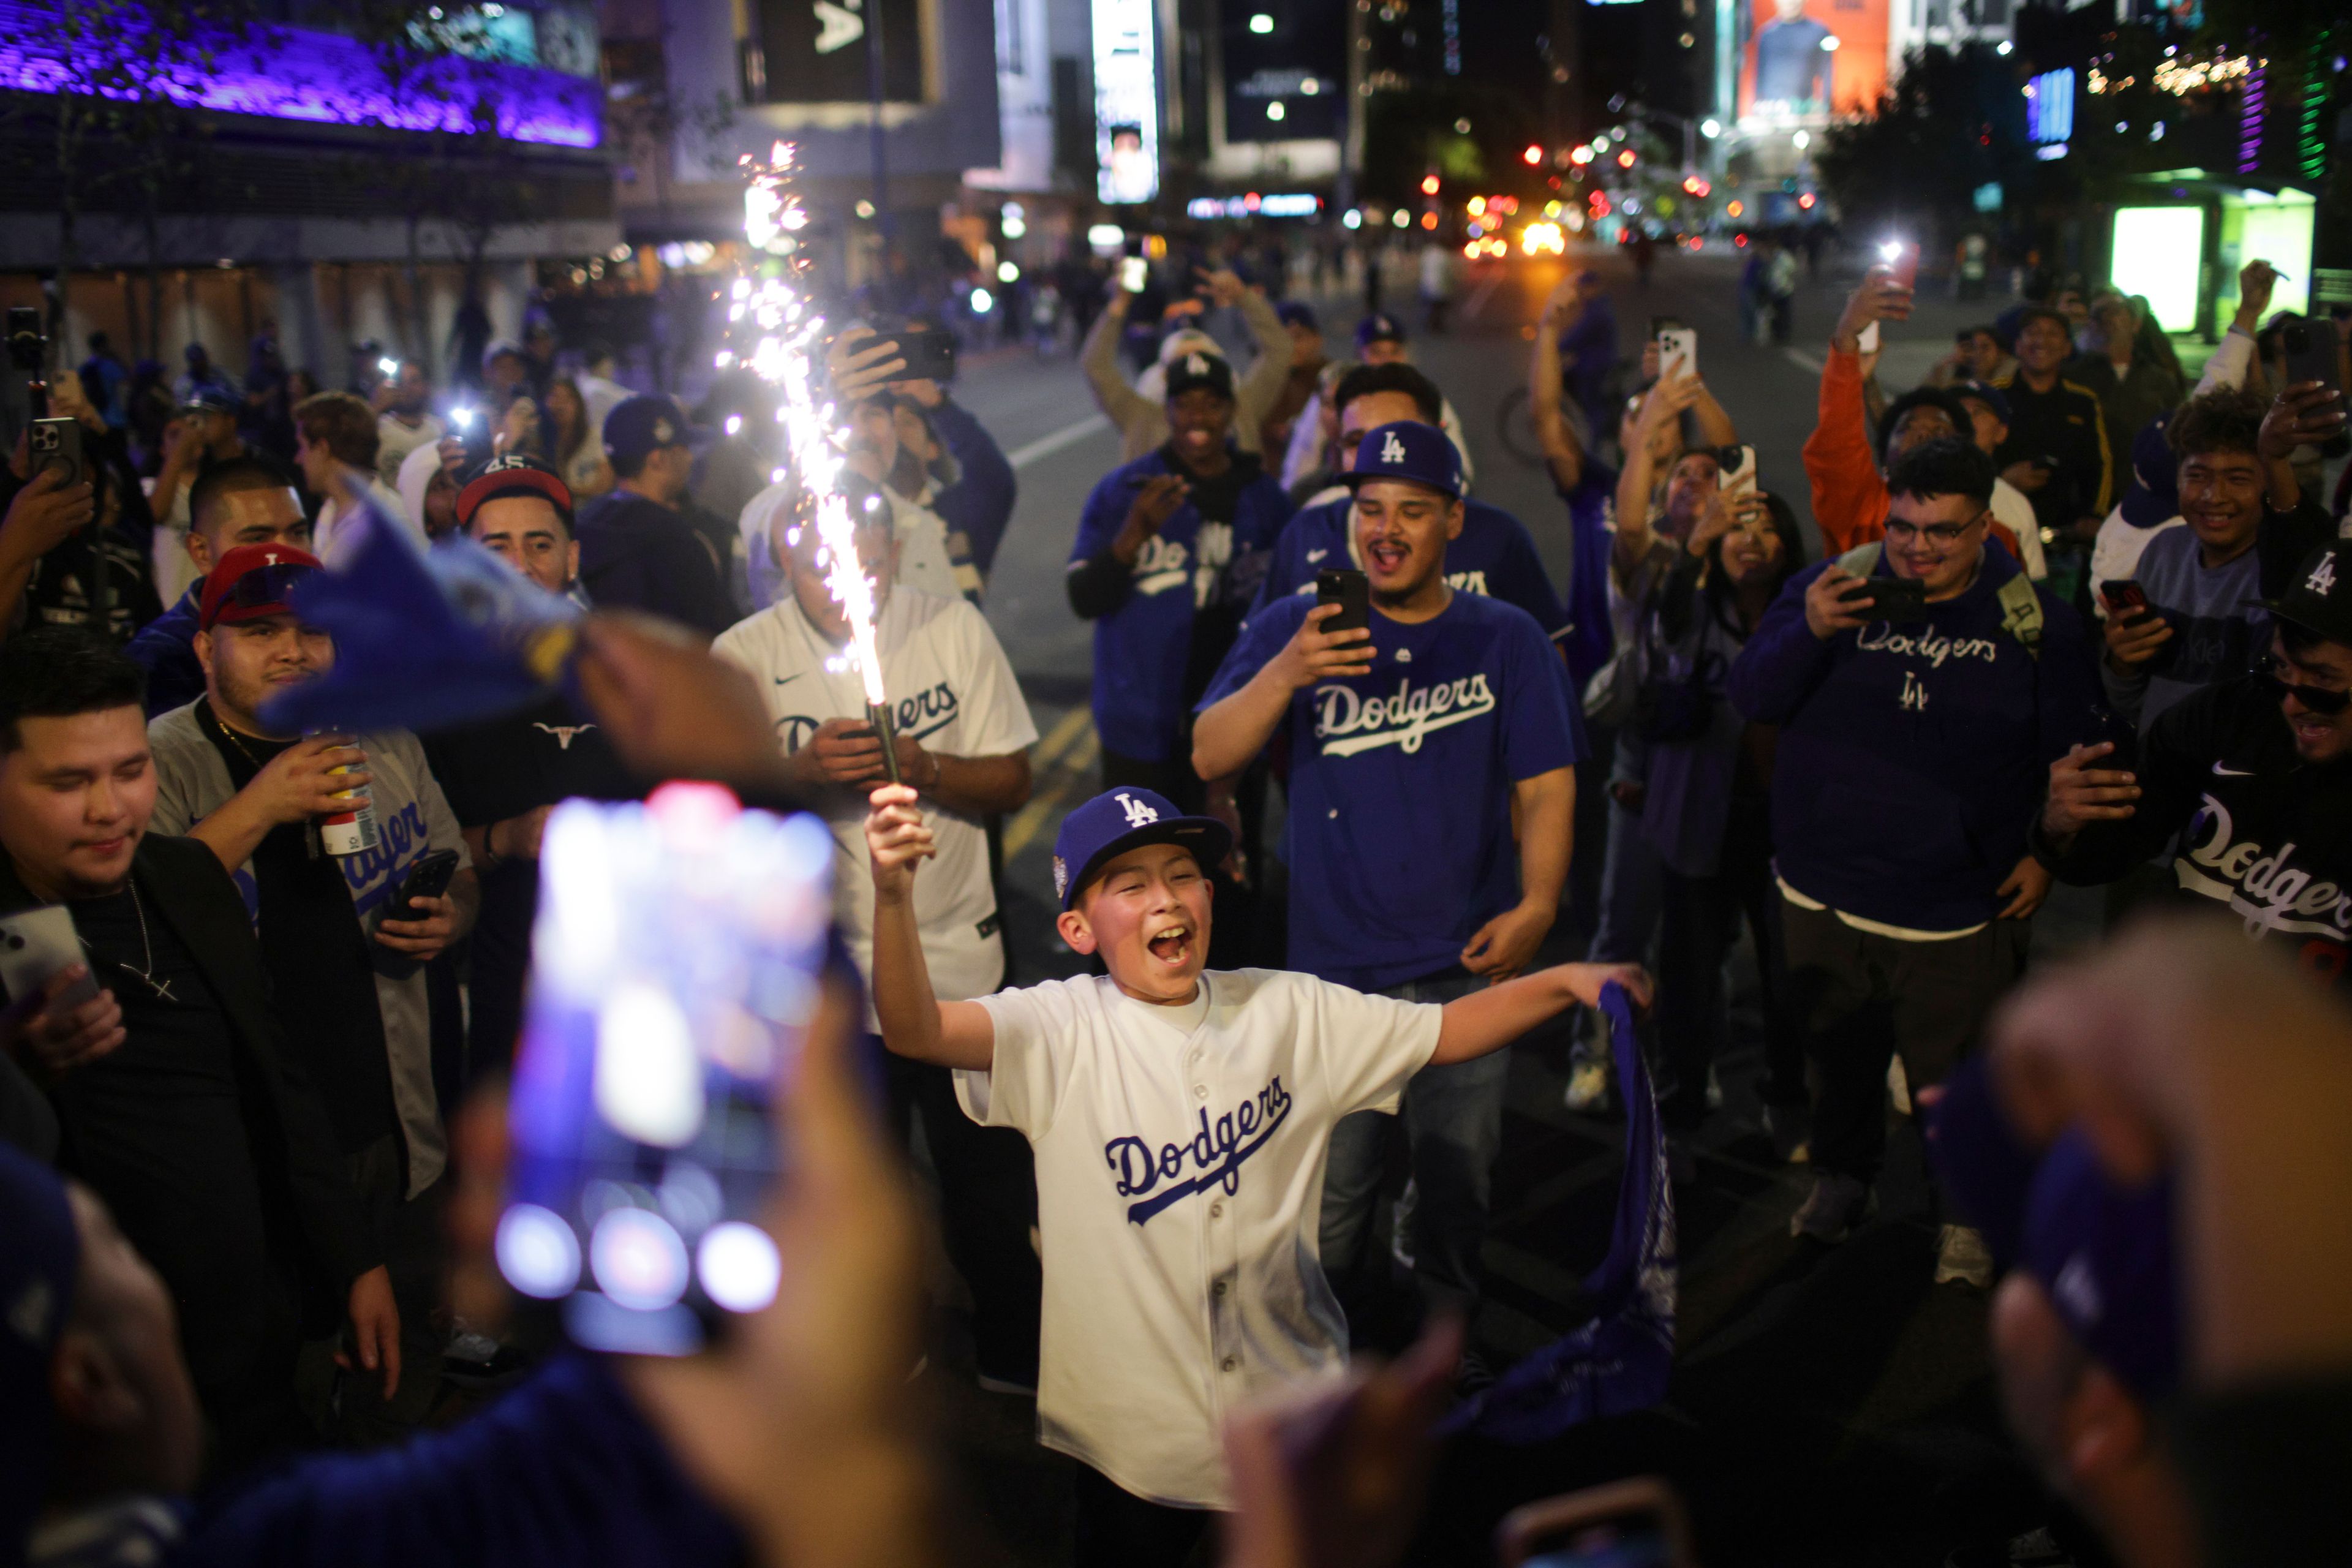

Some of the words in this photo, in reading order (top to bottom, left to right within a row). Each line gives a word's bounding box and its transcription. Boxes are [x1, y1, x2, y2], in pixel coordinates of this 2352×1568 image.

[1381, 431, 1406, 463] LA
[2305, 551, 2337, 595] LA
[1857, 620, 1996, 668] Dodgers
[1316, 673, 1495, 757] Dodgers
[1114, 793, 1159, 828] LA
[1105, 1075, 1291, 1210] Dodgers
